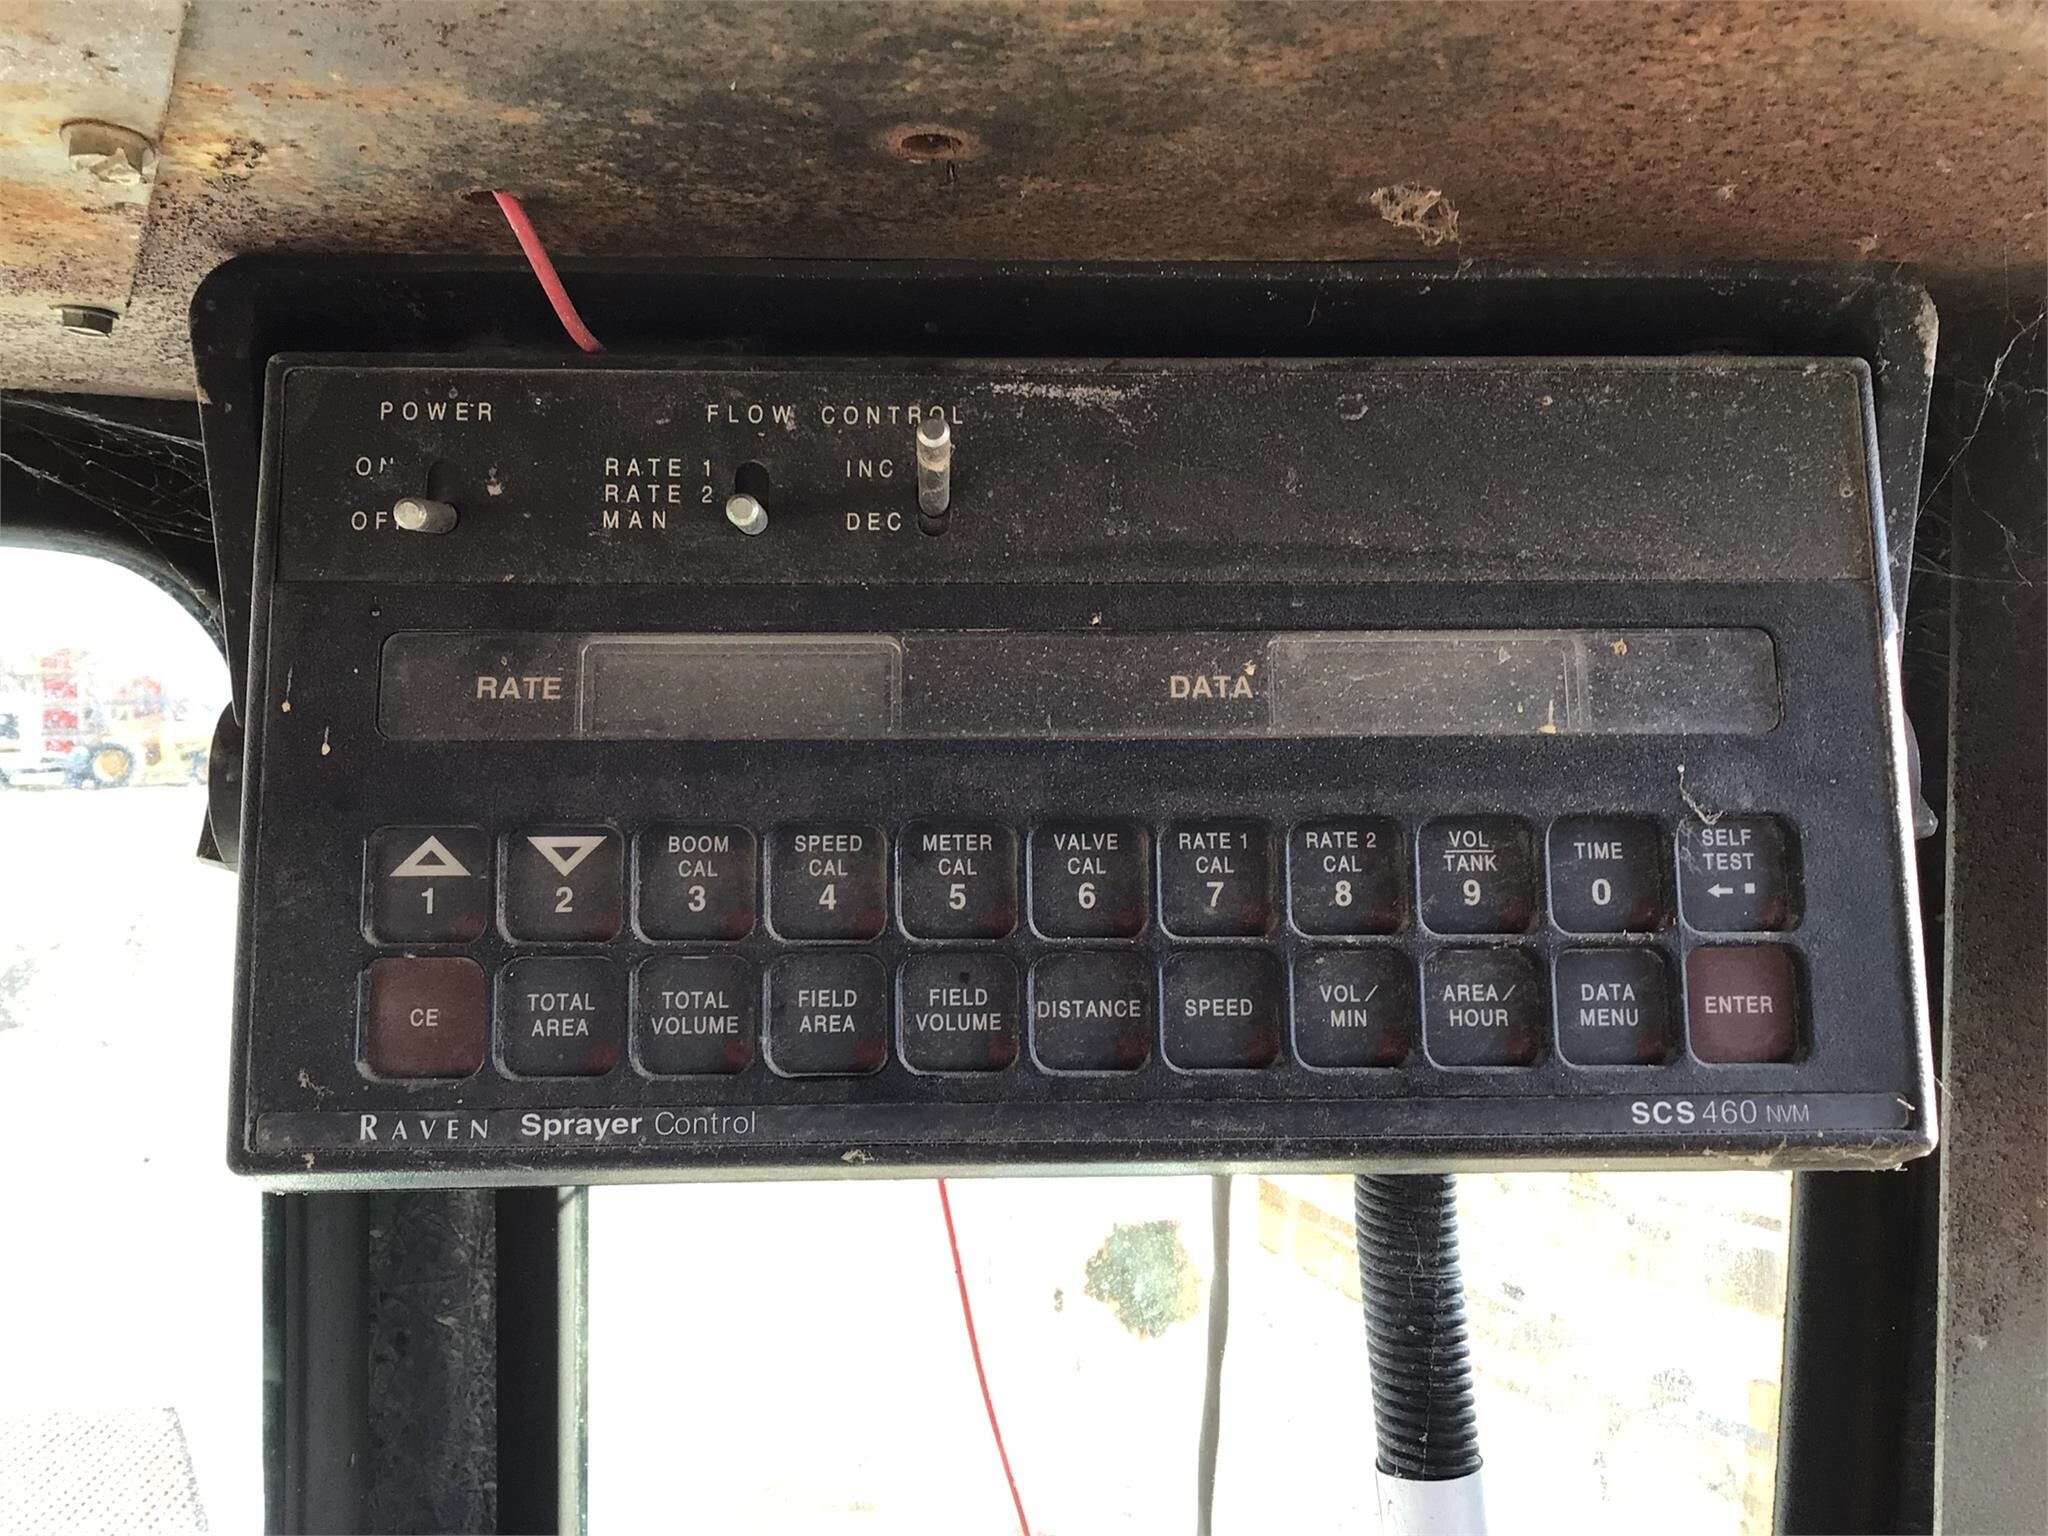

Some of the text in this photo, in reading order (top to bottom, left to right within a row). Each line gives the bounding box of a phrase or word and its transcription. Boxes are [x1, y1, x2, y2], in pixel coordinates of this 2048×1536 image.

[380, 401, 492, 421] POWER
[707, 404, 963, 425] FLOW CONTROL
[605, 458, 711, 477] RATE 1
[846, 459, 893, 478] INC
[605, 484, 713, 503] RATE 2
[351, 511, 400, 531] OF
[602, 510, 666, 529] MAN
[846, 512, 902, 531] DEC
[476, 676, 561, 699] RATE
[1170, 675, 1253, 699] DATA
[668, 836, 729, 854] BOOM
[794, 834, 863, 852] SPEED
[922, 834, 992, 851] METER
[1053, 833, 1118, 851] VALVE
[1178, 832, 1248, 850] RATE 1
[1306, 831, 1377, 849] RATE 2
[1449, 831, 1489, 848] VOL
[1702, 829, 1751, 846] SELF
[1573, 842, 1623, 860] TIME
[678, 860, 717, 878] CAL
[809, 859, 848, 876] CAL
[938, 858, 977, 875] CAL
[1067, 857, 1106, 875] CAL
[1195, 856, 1235, 874] CAL
[1323, 855, 1362, 873] CAL
[1443, 854, 1498, 872] TANK
[1702, 853, 1754, 870] TEST
[421, 887, 434, 914] 1
[555, 887, 573, 913] 2
[688, 886, 706, 912] 3
[818, 884, 837, 910] 4
[949, 883, 966, 910] 5
[1078, 882, 1096, 909] 6
[1206, 882, 1225, 908] 7
[1335, 880, 1353, 907] 8
[1463, 879, 1481, 906] 9
[1592, 878, 1611, 906] 0
[661, 991, 729, 1010] TOTAL
[798, 989, 857, 1008] FIELD
[929, 988, 987, 1007] FIELD
[1581, 983, 1636, 1001] DATA
[526, 992, 596, 1012] TOTAL
[1037, 1000, 1141, 1018] DISTANCE
[1184, 999, 1253, 1017] SPEED
[1705, 996, 1773, 1014] ENTER
[409, 1008, 439, 1027] CE
[651, 1016, 739, 1035] VOLUME
[799, 1014, 855, 1033] AREA
[915, 1012, 1002, 1032] VOLUME
[1330, 1009, 1367, 1027] MIN
[1449, 1008, 1509, 1027] HOUR
[1580, 1008, 1639, 1027] MENU
[531, 1018, 589, 1037] AREA
[1631, 1100, 1809, 1124] SCS 460 NVM
[359, 1111, 756, 1141] RAVEN Sprayer Control
